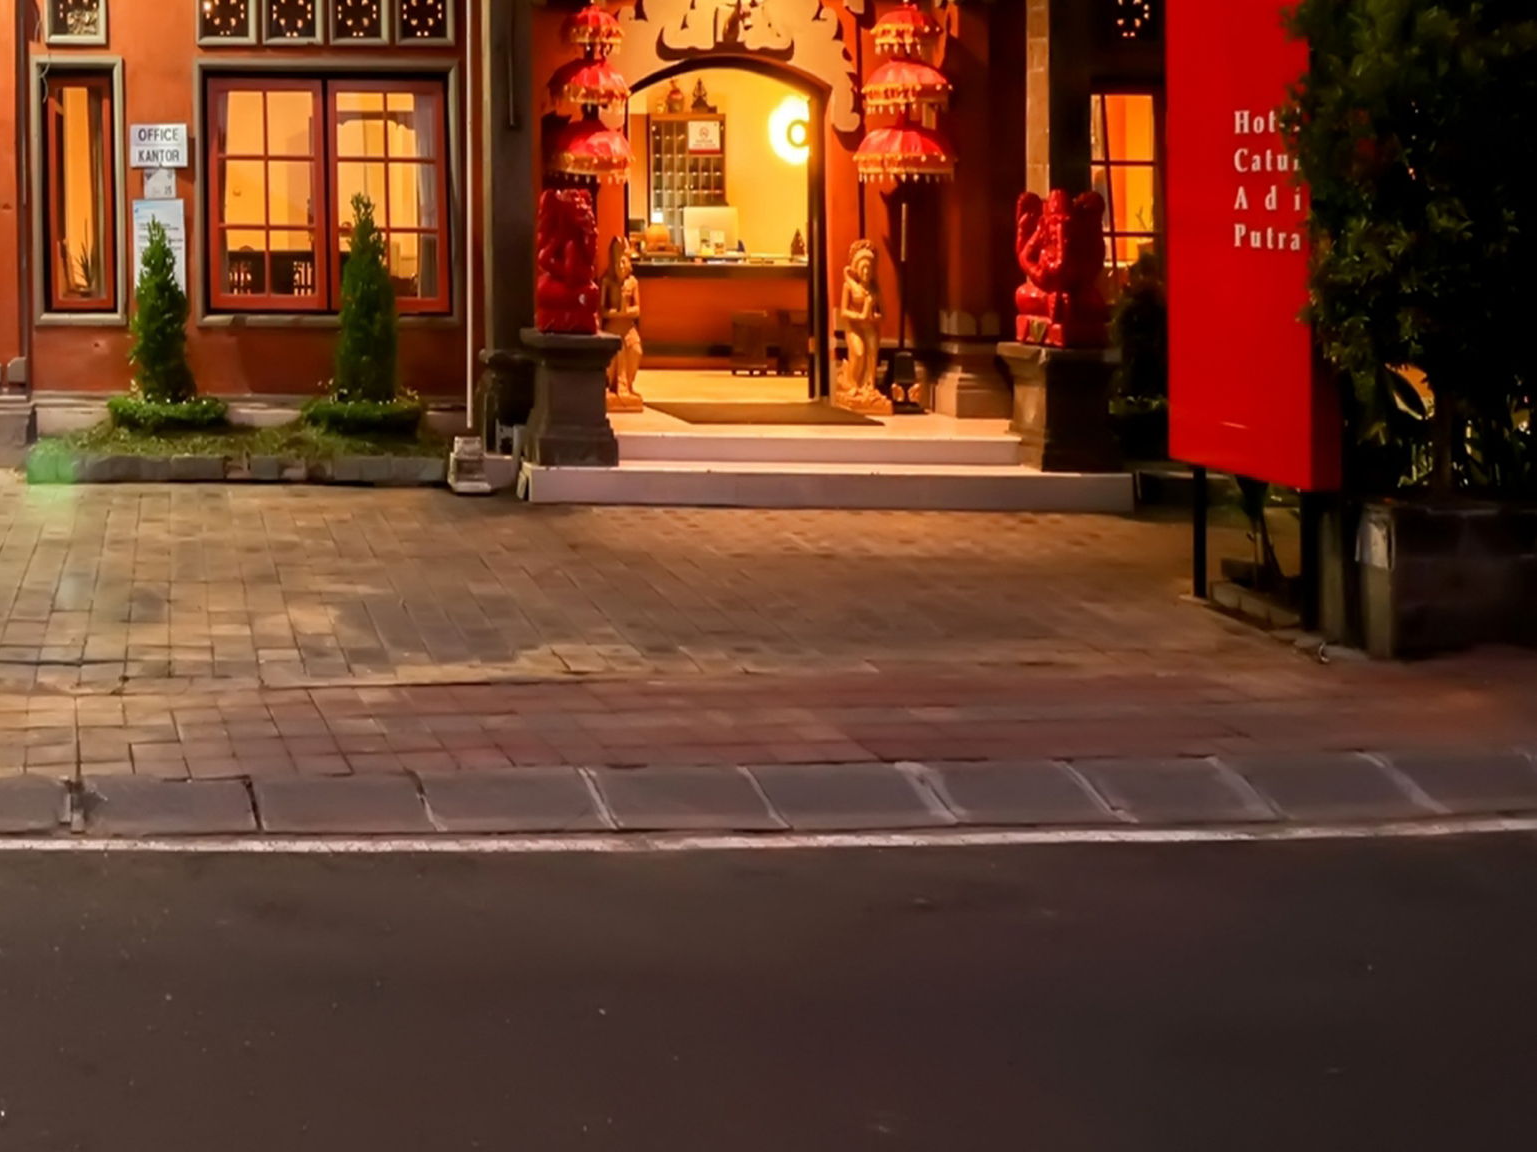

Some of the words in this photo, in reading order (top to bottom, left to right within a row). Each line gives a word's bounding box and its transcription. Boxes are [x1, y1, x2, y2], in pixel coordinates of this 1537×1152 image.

[1234, 110, 1301, 134] Hot
[138, 128, 179, 141] OFFICE
[138, 149, 179, 162] KANTOR
[1234, 223, 1301, 250] Putra
